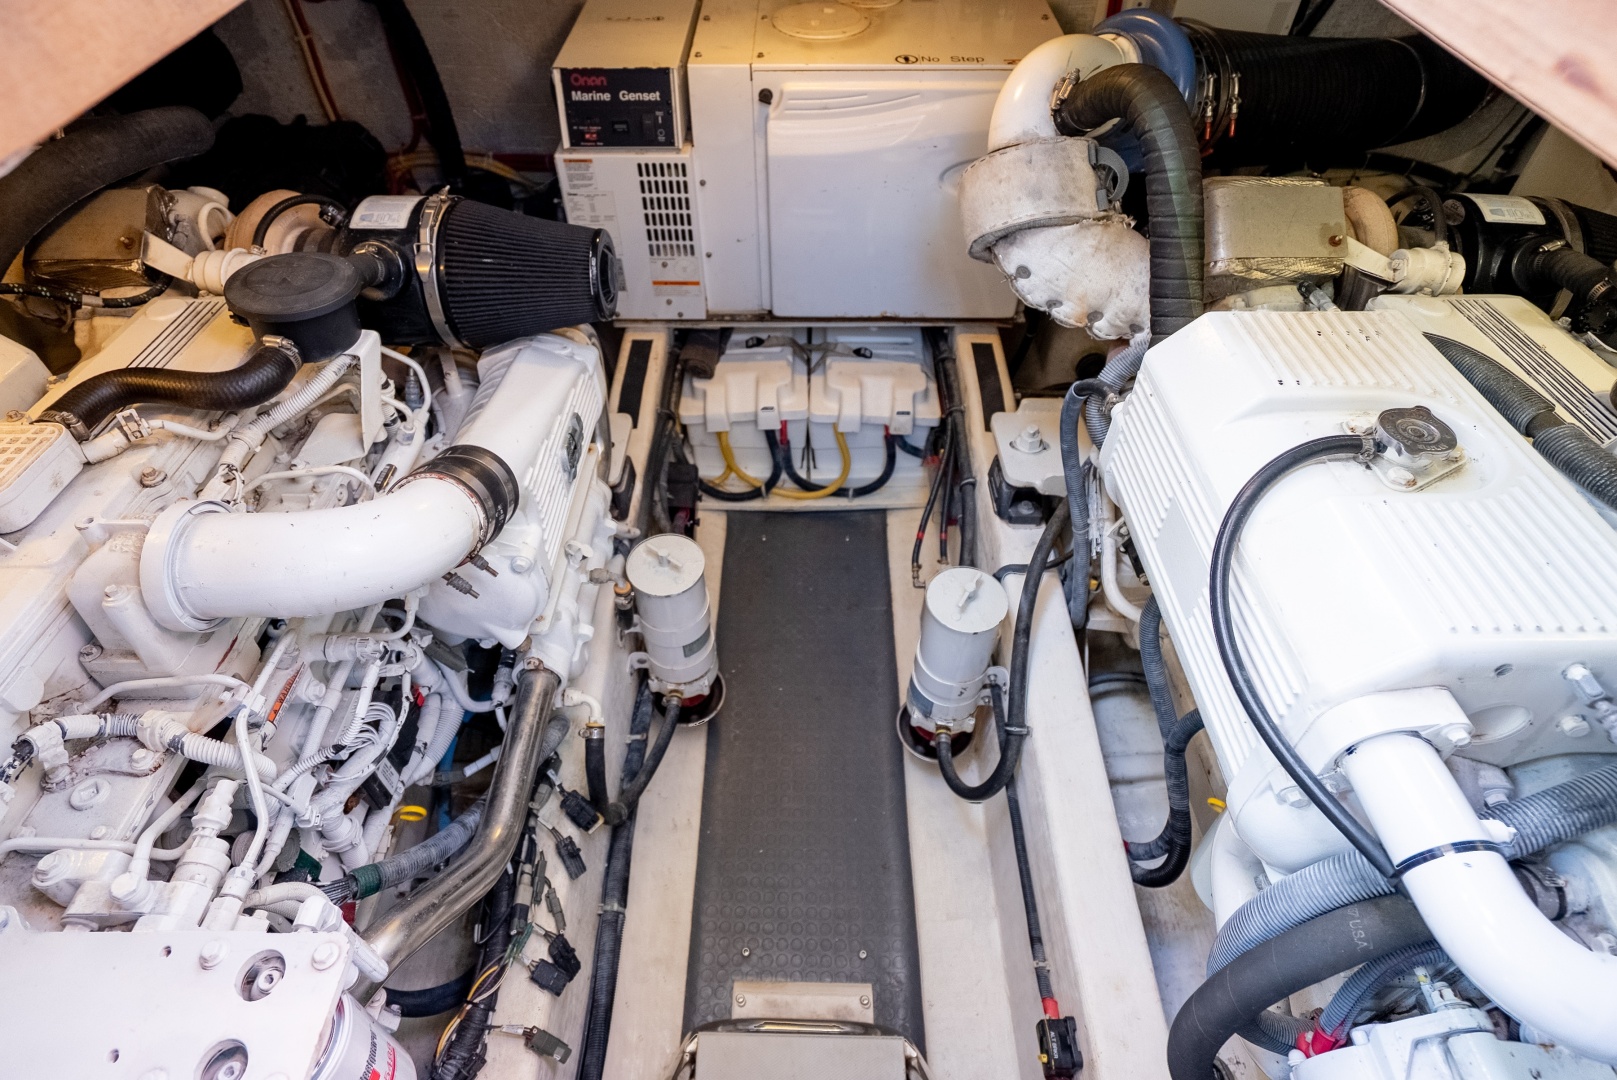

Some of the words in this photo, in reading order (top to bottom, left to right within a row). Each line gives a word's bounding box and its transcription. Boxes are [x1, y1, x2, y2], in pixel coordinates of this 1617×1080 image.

[950, 56, 985, 64] Step
[570, 73, 607, 86] Onan
[571, 90, 611, 101] Marine
[619, 90, 661, 101] Genset
